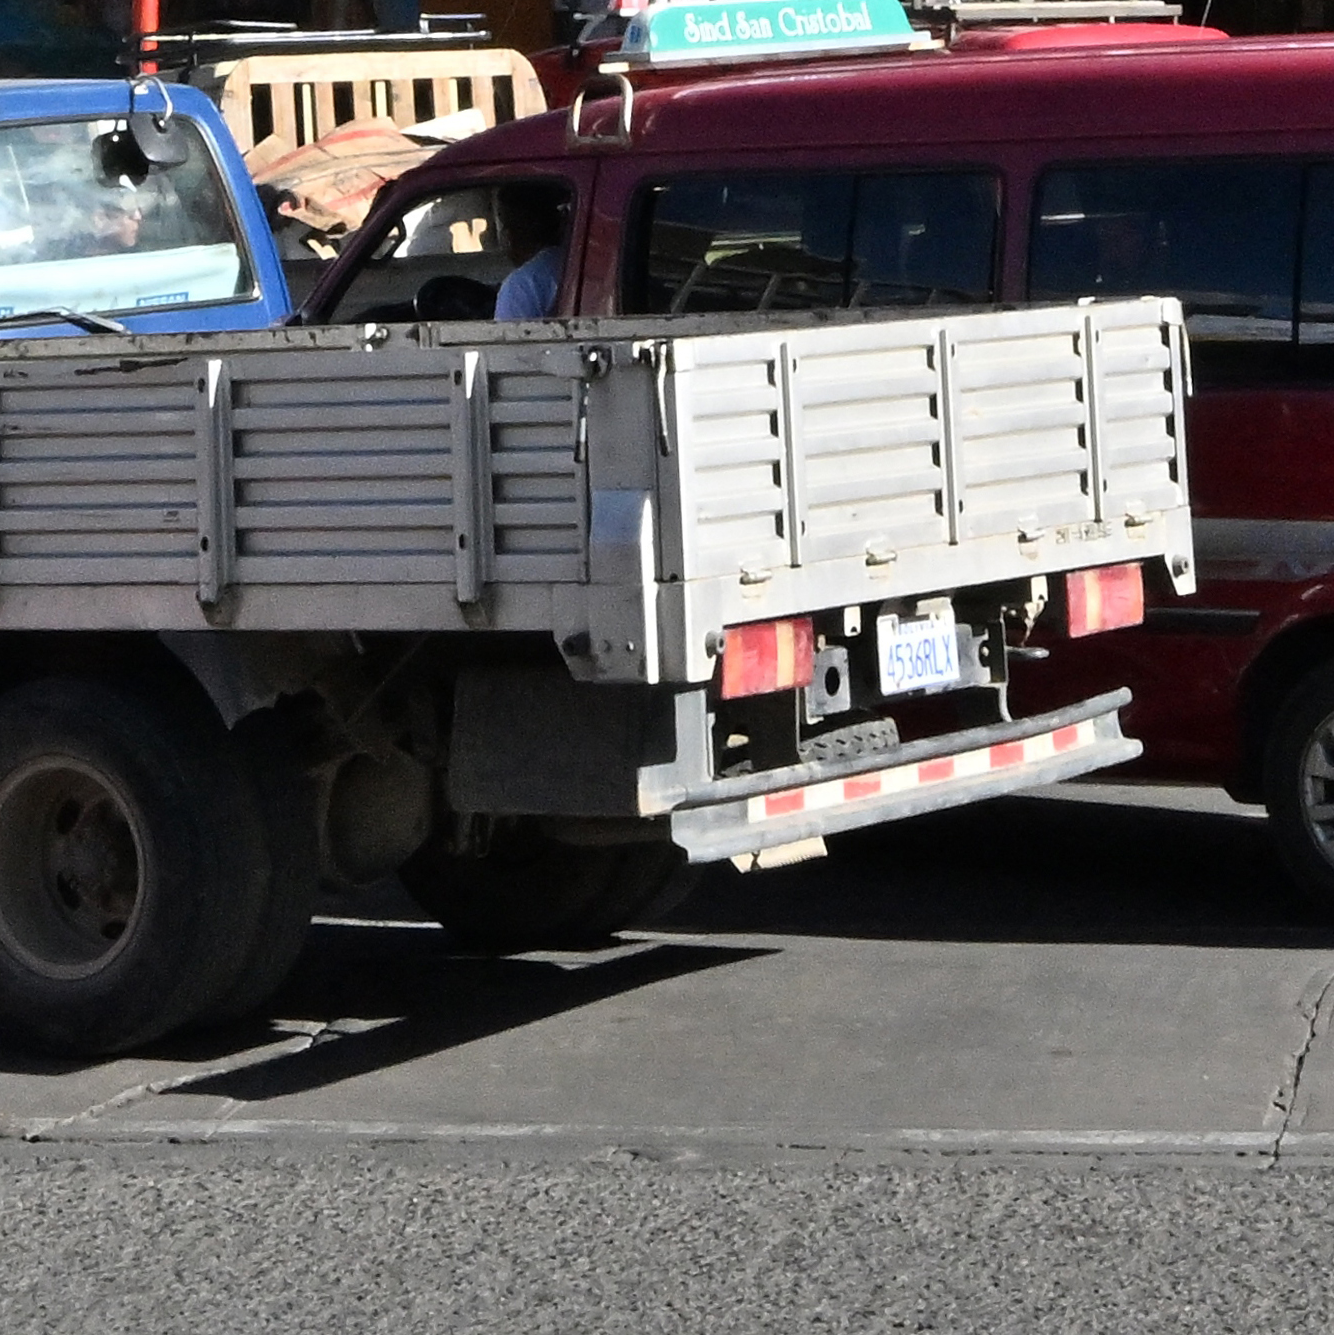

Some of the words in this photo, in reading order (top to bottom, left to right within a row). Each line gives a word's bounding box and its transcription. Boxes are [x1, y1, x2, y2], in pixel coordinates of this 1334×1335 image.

[735, 11, 774, 40] San
[778, 0, 873, 38] Cristobal
[887, 634, 953, 680] 4536RLX
